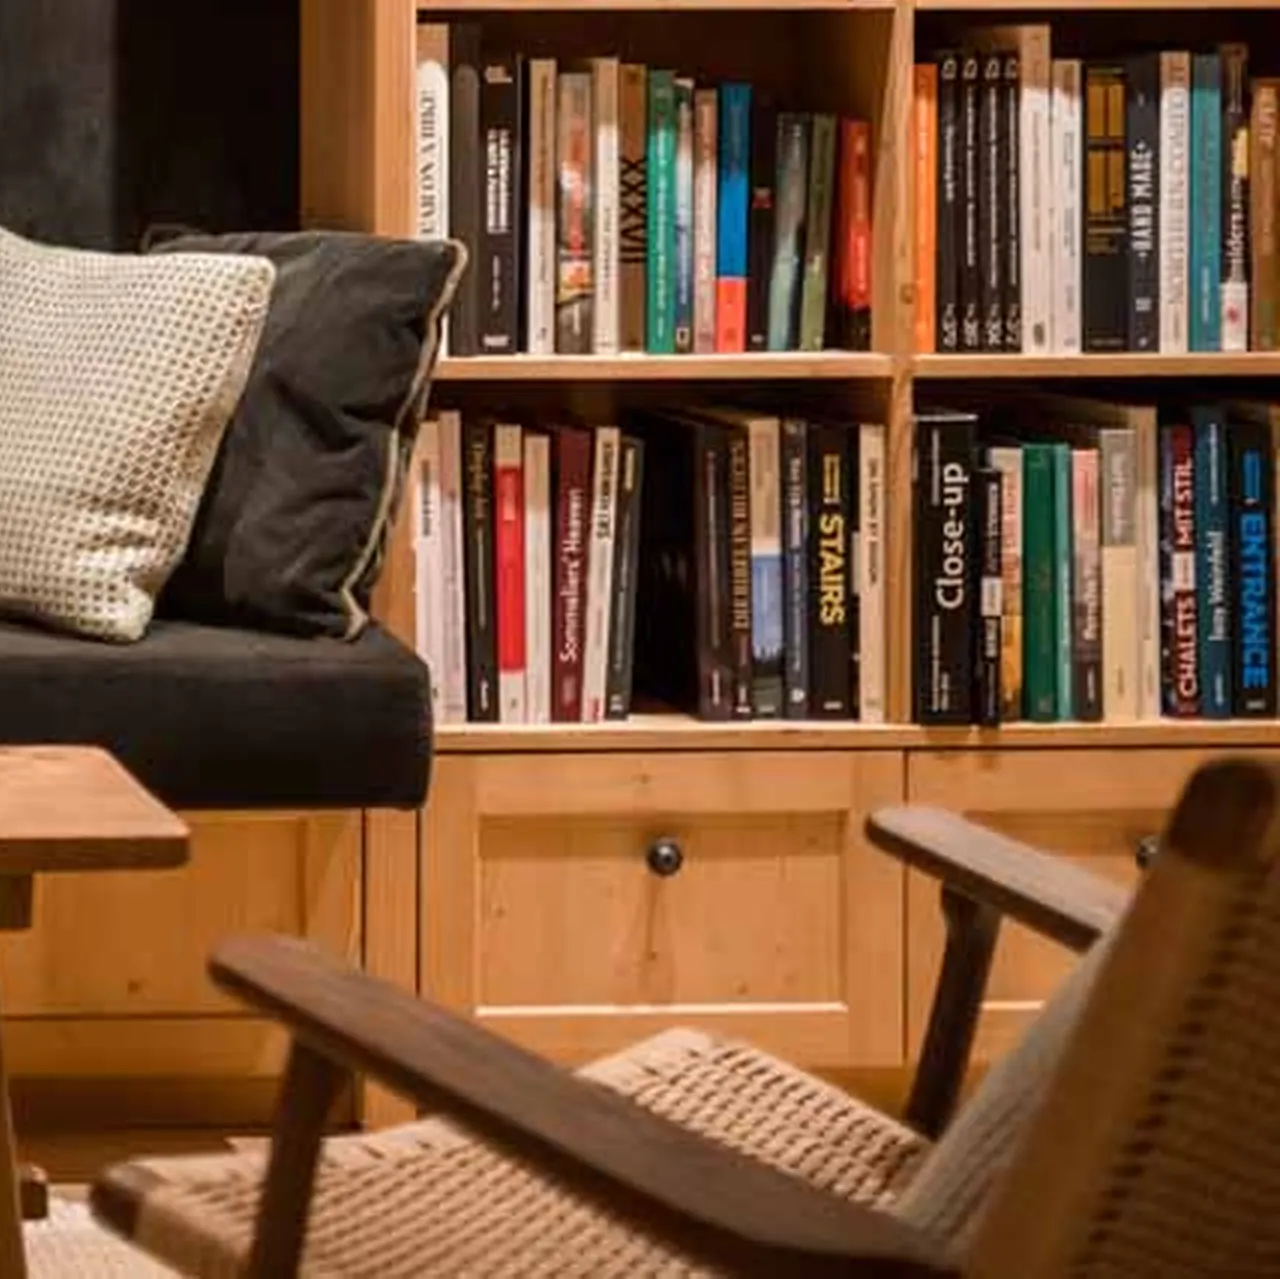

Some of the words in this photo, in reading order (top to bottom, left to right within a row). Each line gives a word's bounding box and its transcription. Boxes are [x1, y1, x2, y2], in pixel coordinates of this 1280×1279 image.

[619, 157, 648, 265] XXXVII
[563, 488, 582, 552] Heaven
[1173, 458, 1192, 503] STIL
[1175, 507, 1193, 546] MIT
[819, 513, 845, 625] STAIRS
[936, 461, 968, 609] Close-up
[1177, 597, 1197, 697] CHALETS
[1241, 513, 1268, 690] ENTRANCE
